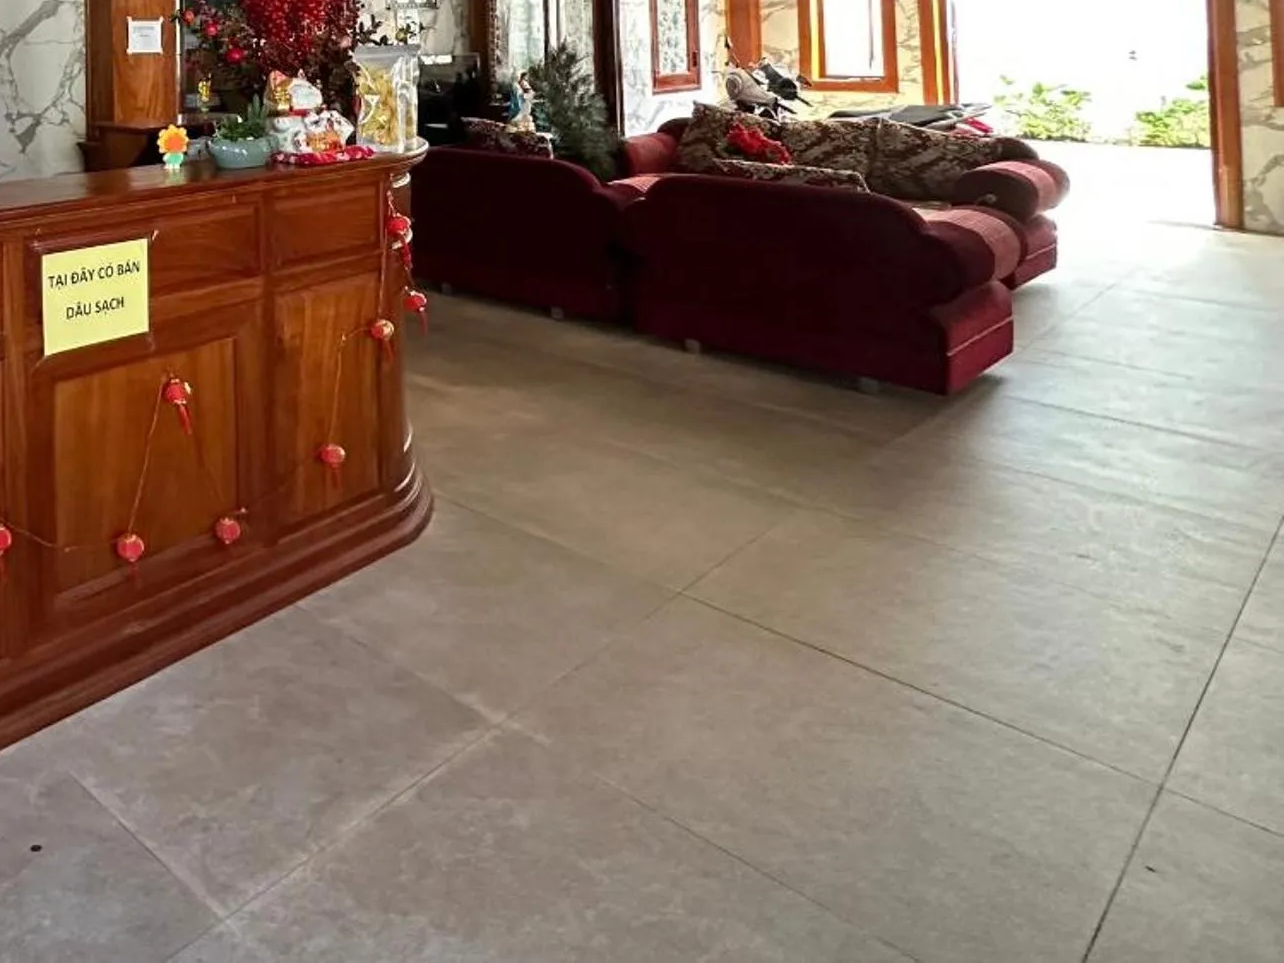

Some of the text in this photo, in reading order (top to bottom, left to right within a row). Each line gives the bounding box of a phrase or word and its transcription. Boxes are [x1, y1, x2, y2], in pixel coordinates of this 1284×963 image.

[48, 259, 140, 290] TẠI ĐÂY CÓ BÁN
[95, 296, 124, 315] SẠCH
